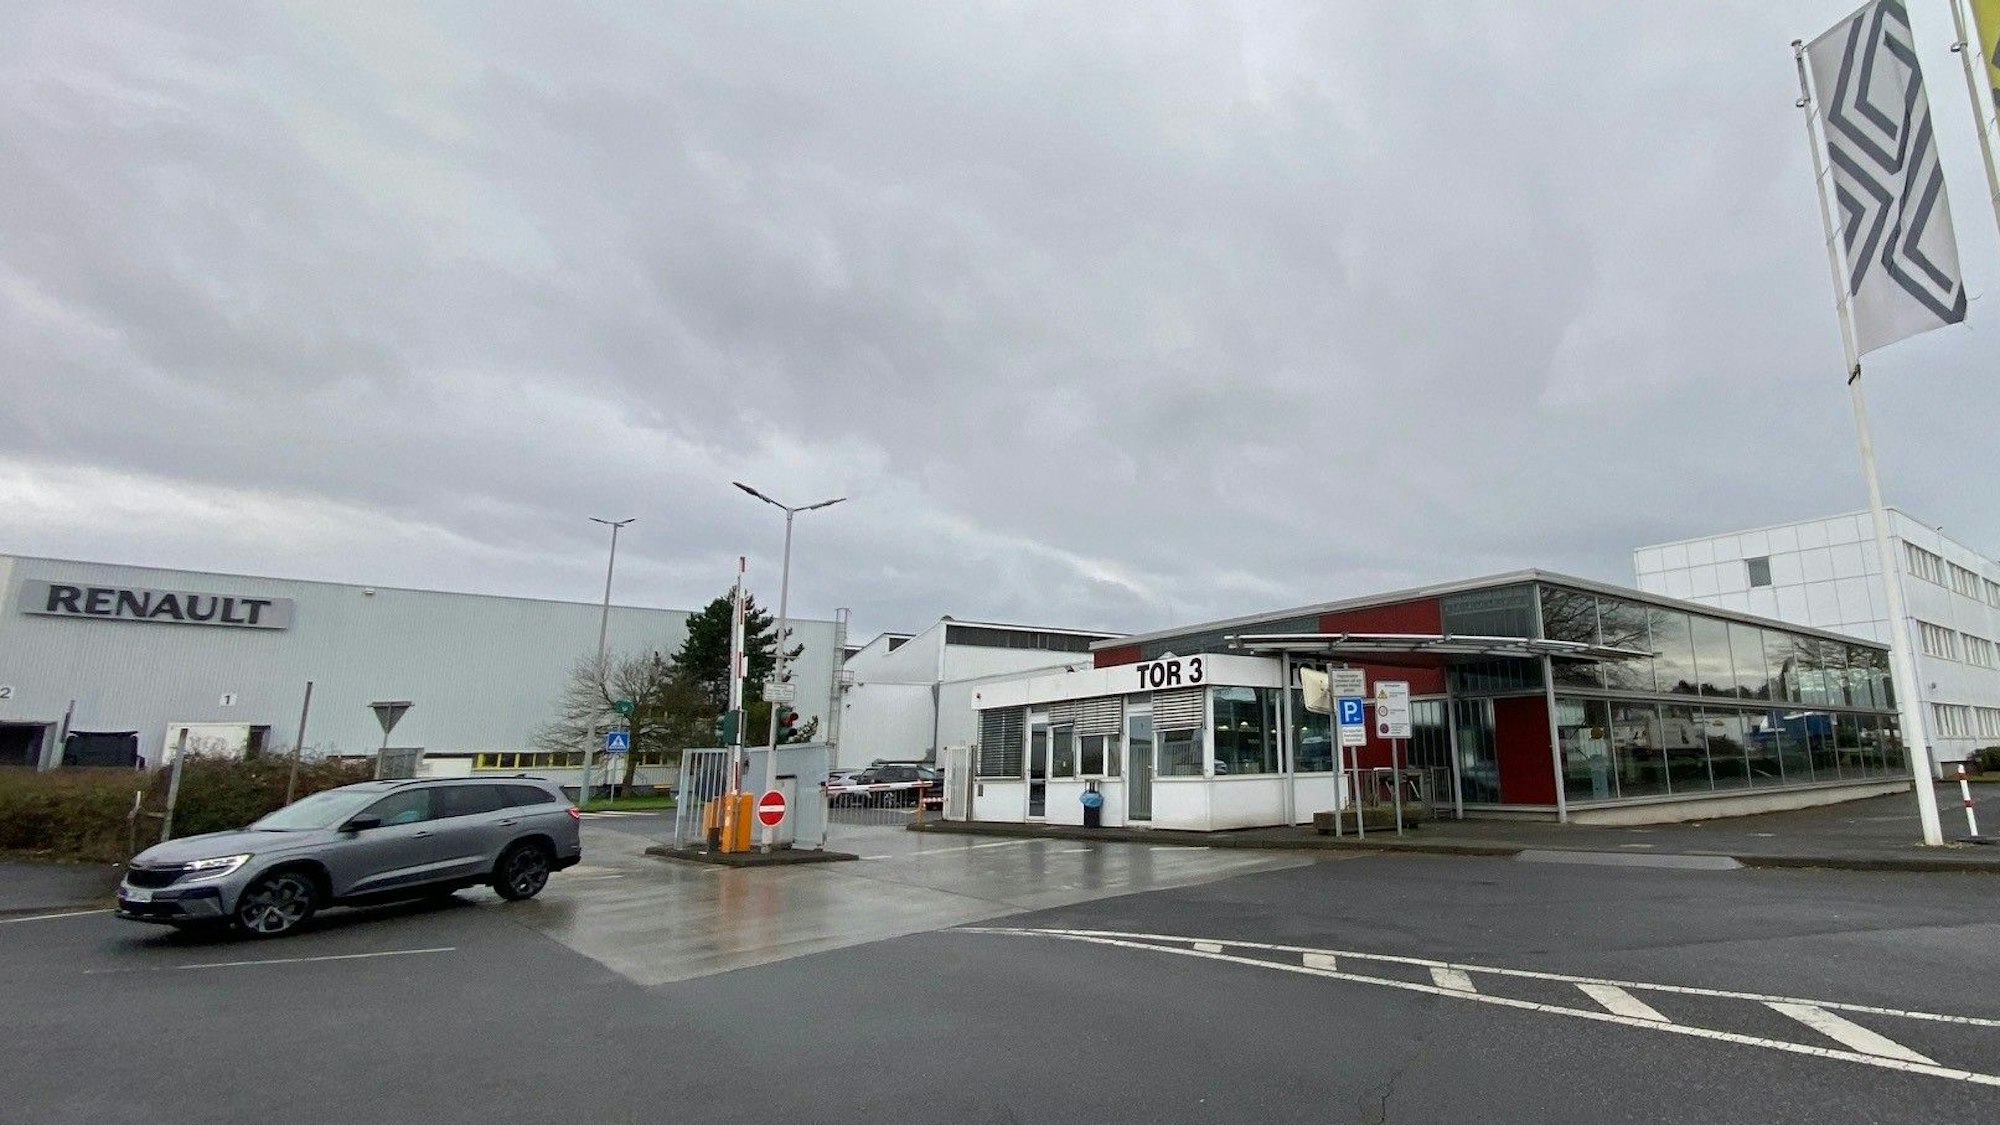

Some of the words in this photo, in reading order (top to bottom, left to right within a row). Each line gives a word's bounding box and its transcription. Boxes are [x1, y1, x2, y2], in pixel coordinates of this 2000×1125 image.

[47, 584, 272, 624] RENAULT
[1136, 661, 1181, 689] TOR
[1189, 657, 1203, 683] 3
[0, 687, 11, 699] 2
[225, 695, 231, 705] 1
[1344, 701, 1358, 722] P
